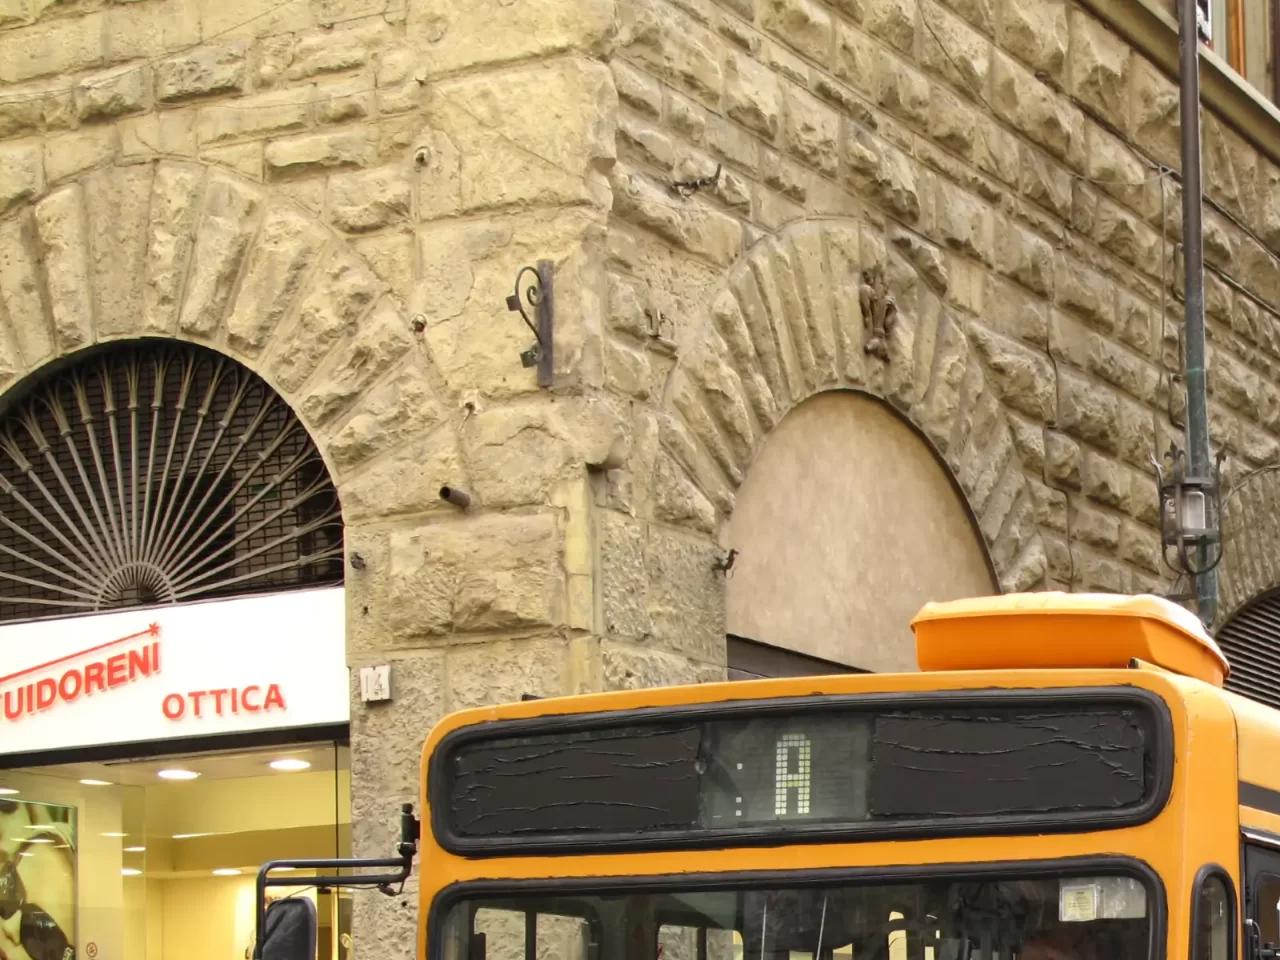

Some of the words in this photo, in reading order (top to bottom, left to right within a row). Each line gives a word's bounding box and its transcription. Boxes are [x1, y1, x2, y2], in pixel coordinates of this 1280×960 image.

[0, 642, 160, 719] UIDORENI
[162, 684, 287, 719] OTTICA
[775, 733, 811, 815] A
